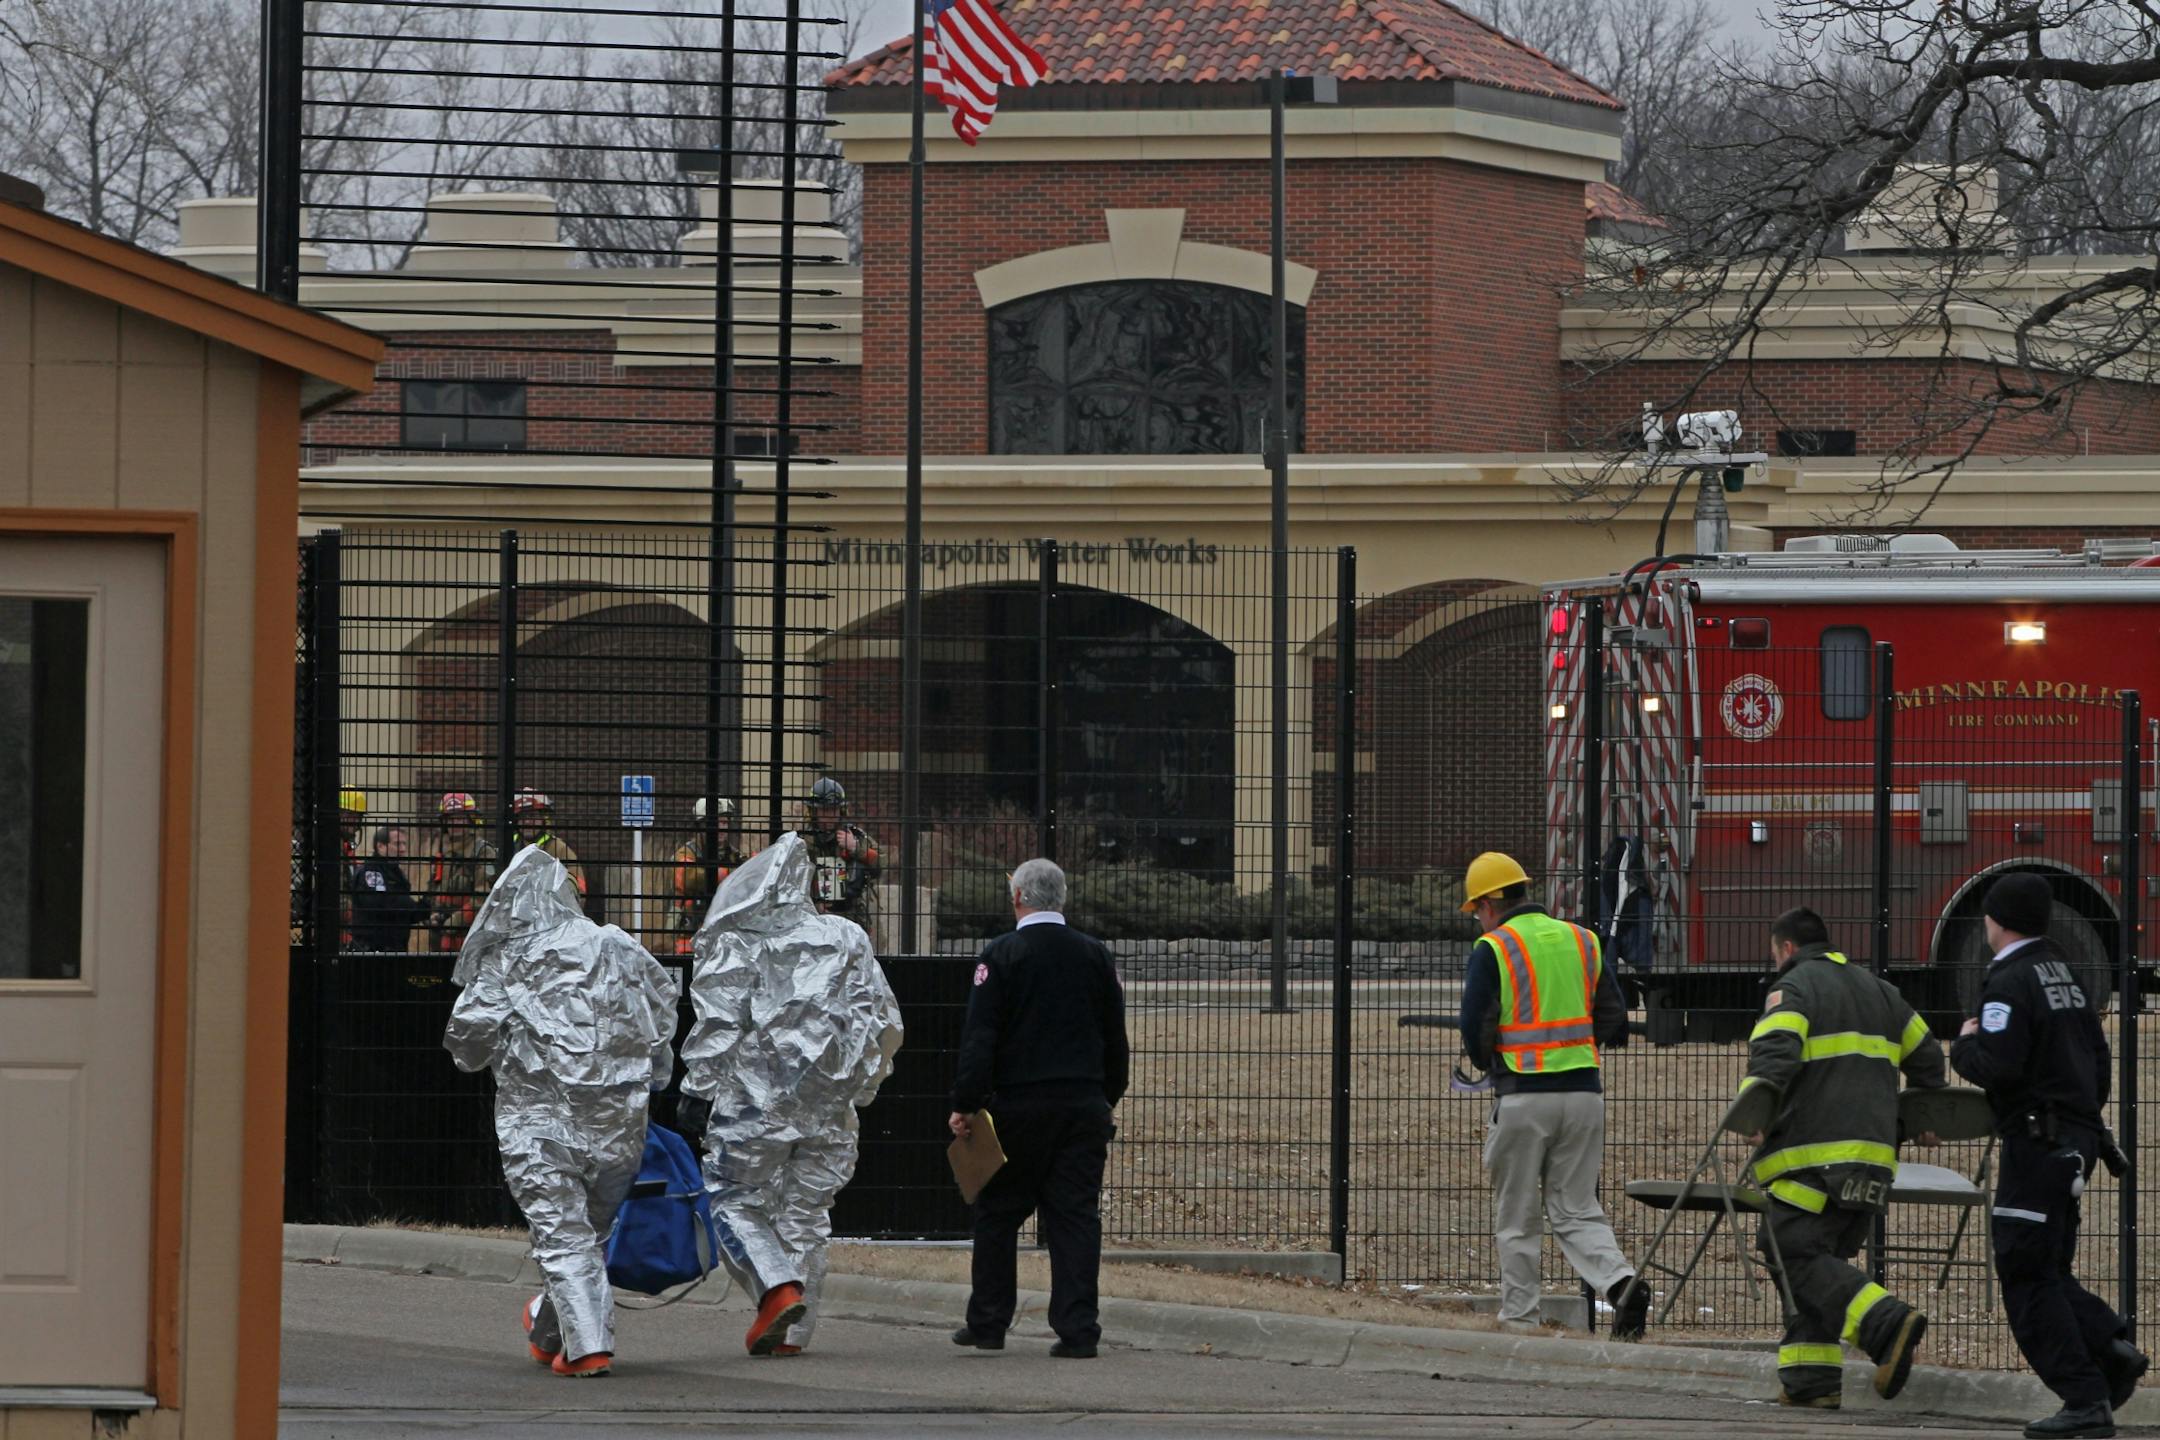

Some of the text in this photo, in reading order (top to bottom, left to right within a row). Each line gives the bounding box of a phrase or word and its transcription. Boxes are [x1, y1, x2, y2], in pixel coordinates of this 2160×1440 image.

[824, 537, 1010, 570] Minnapolis
[1125, 537, 1218, 564] Works
[1895, 679, 2124, 712] MINNEAPOLIS
[1949, 713, 2079, 727] FIRE COMMAND
